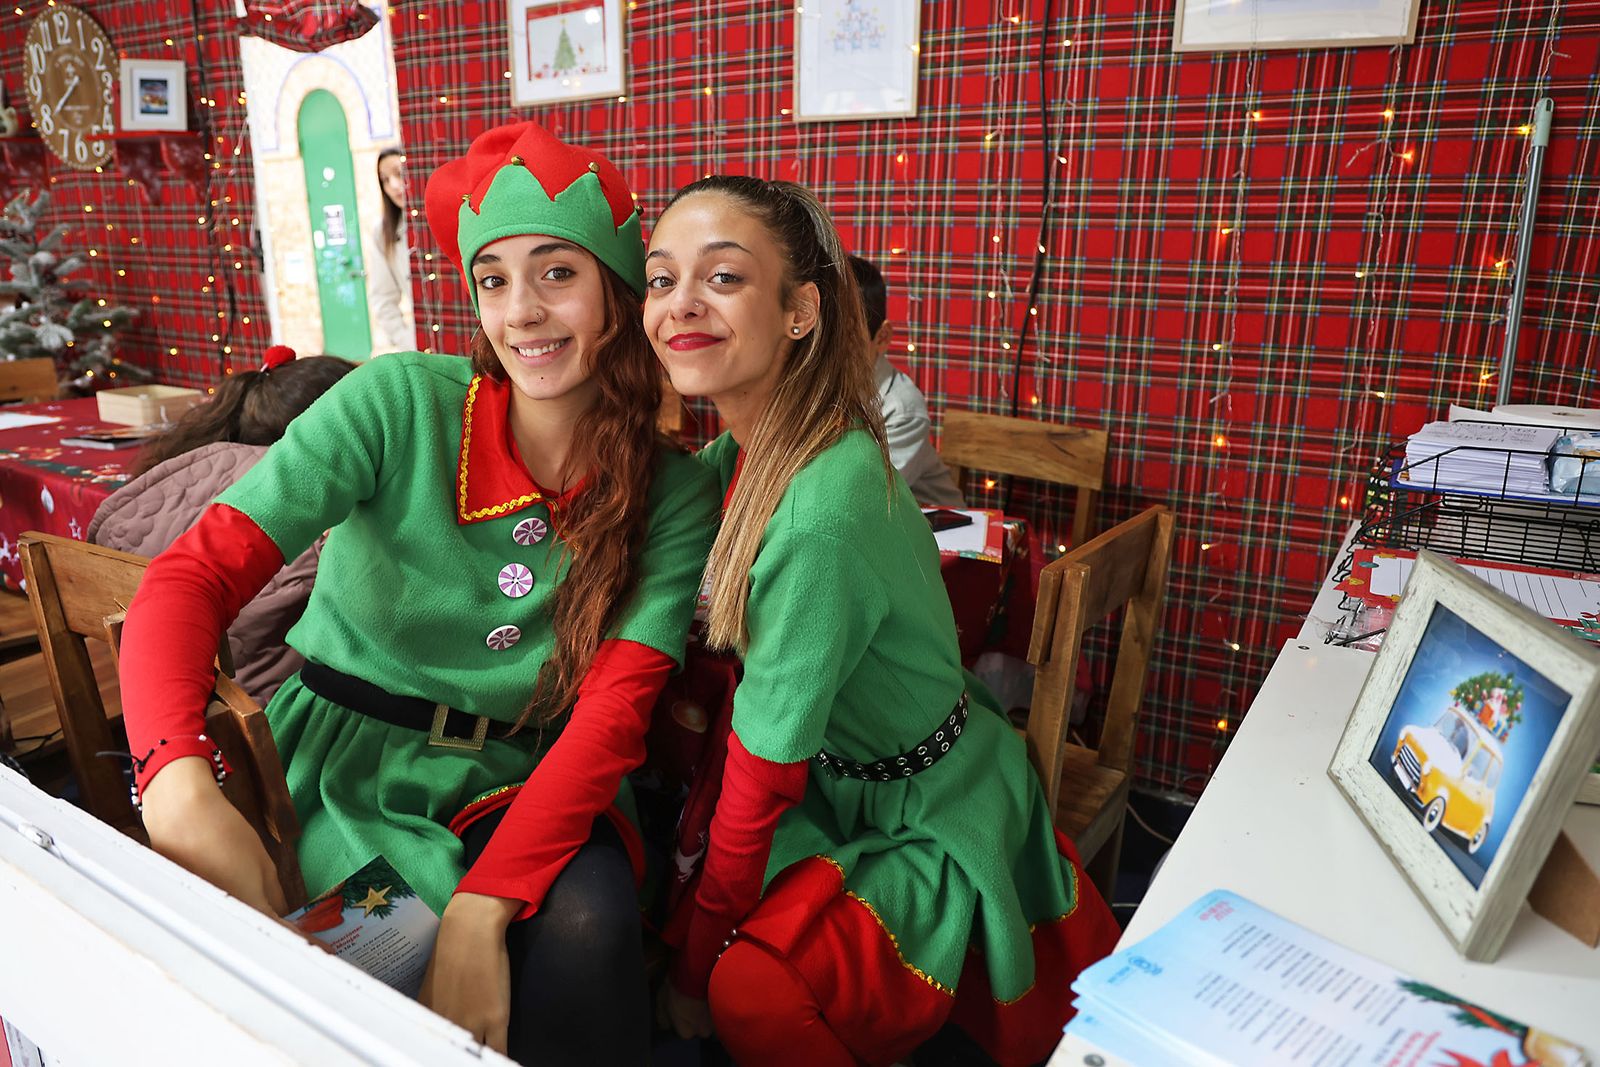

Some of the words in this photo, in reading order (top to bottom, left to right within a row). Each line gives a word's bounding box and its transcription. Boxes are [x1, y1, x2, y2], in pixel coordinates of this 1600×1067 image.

[39, 20, 53, 52] 11
[53, 11, 72, 45] 12
[76, 19, 86, 51] 1
[29, 42, 46, 75] 10
[91, 37, 107, 70] 2
[29, 73, 42, 104] 9
[101, 71, 114, 104] 3
[40, 103, 55, 136] 8
[102, 104, 114, 135] 4
[58, 128, 70, 163] 7
[75, 131, 88, 163] 6
